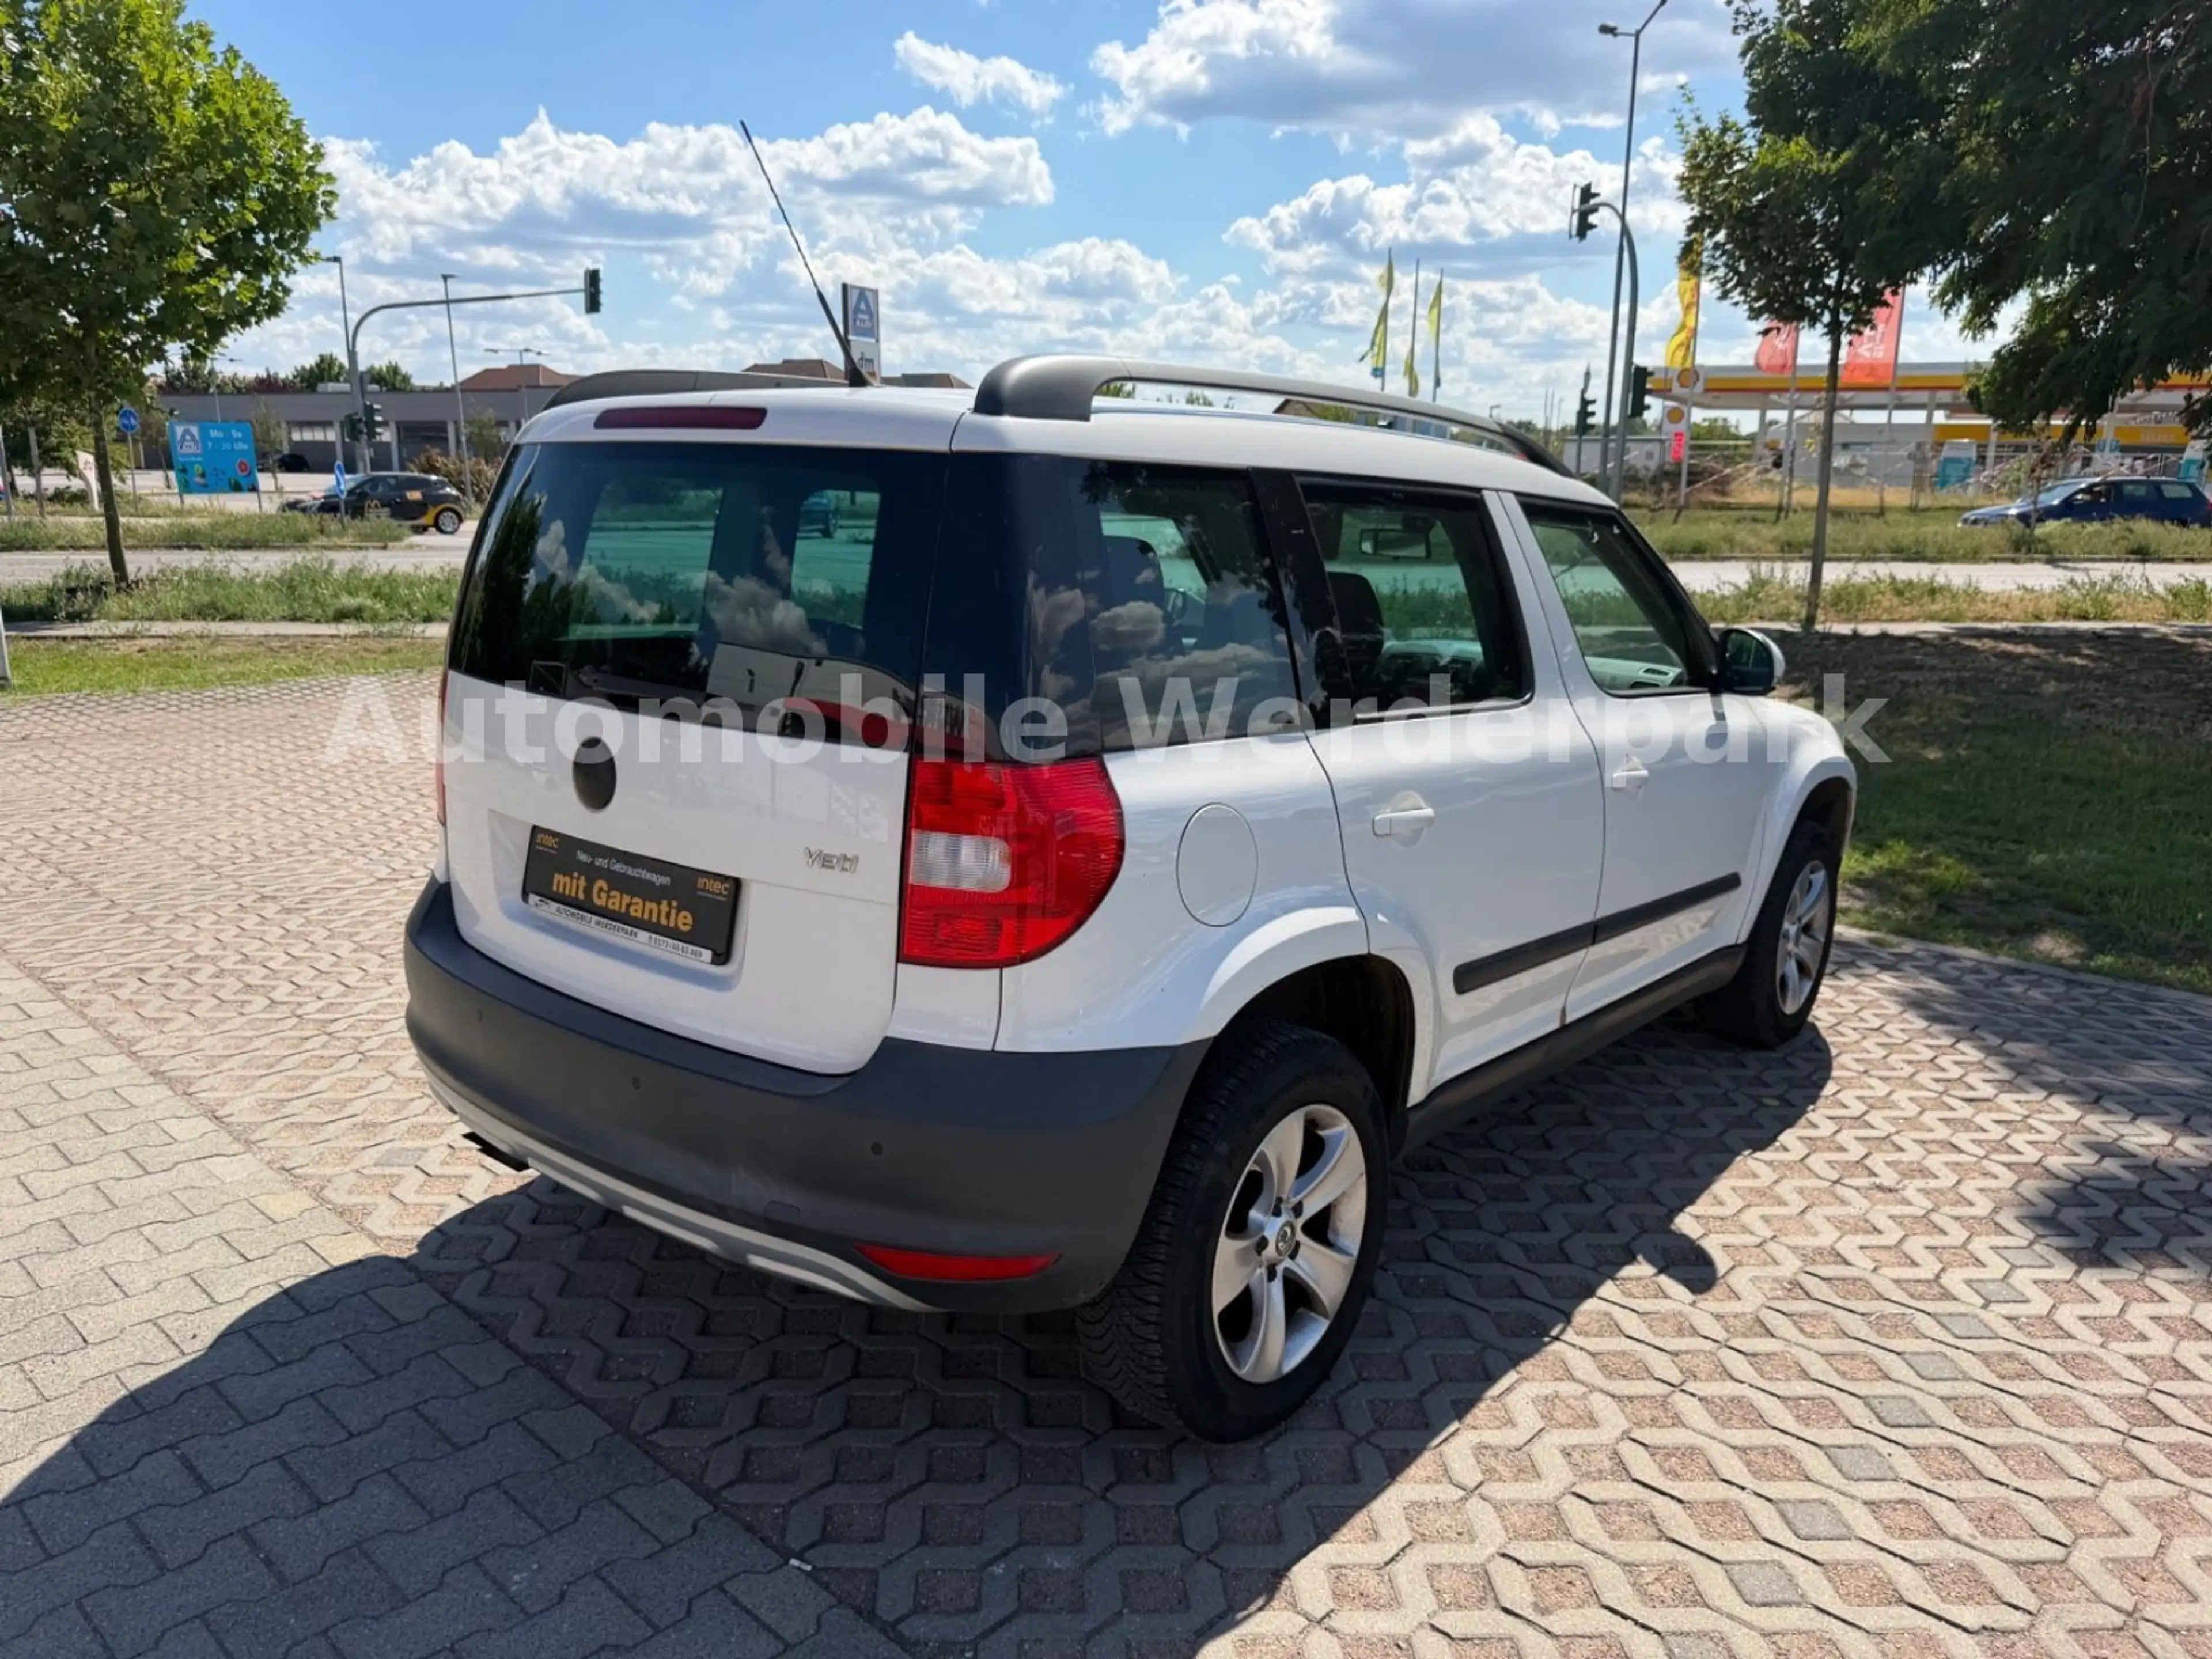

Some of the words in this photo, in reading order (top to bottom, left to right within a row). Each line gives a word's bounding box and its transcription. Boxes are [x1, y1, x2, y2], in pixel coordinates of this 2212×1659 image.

[594, 857, 608, 869] und
[609, 858, 671, 886] Gebrauchtwagen
[552, 872, 586, 900] mit
[593, 879, 694, 932] Garantie
